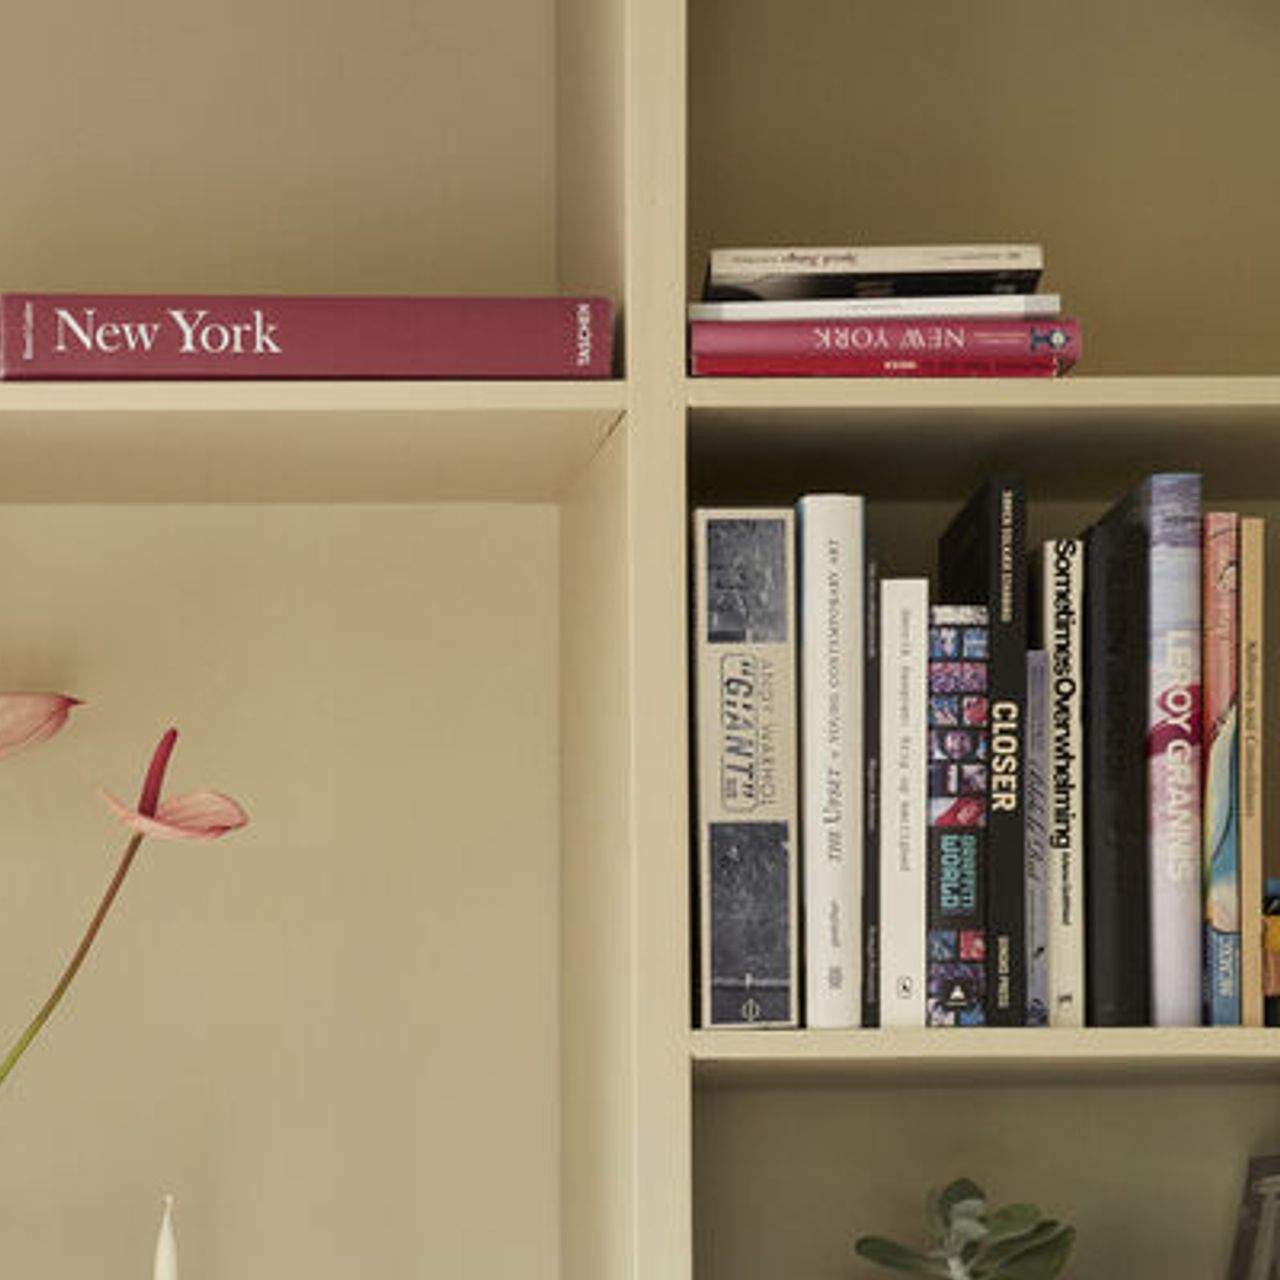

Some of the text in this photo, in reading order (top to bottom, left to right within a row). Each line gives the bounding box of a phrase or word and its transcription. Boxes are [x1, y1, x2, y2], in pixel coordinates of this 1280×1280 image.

[54, 308, 161, 353] New
[167, 308, 282, 354] York
[812, 327, 889, 351] YORK
[901, 327, 967, 350] NEW
[991, 702, 1018, 811] CLOSER
[1163, 631, 1193, 882] LEROY GRANNIS
